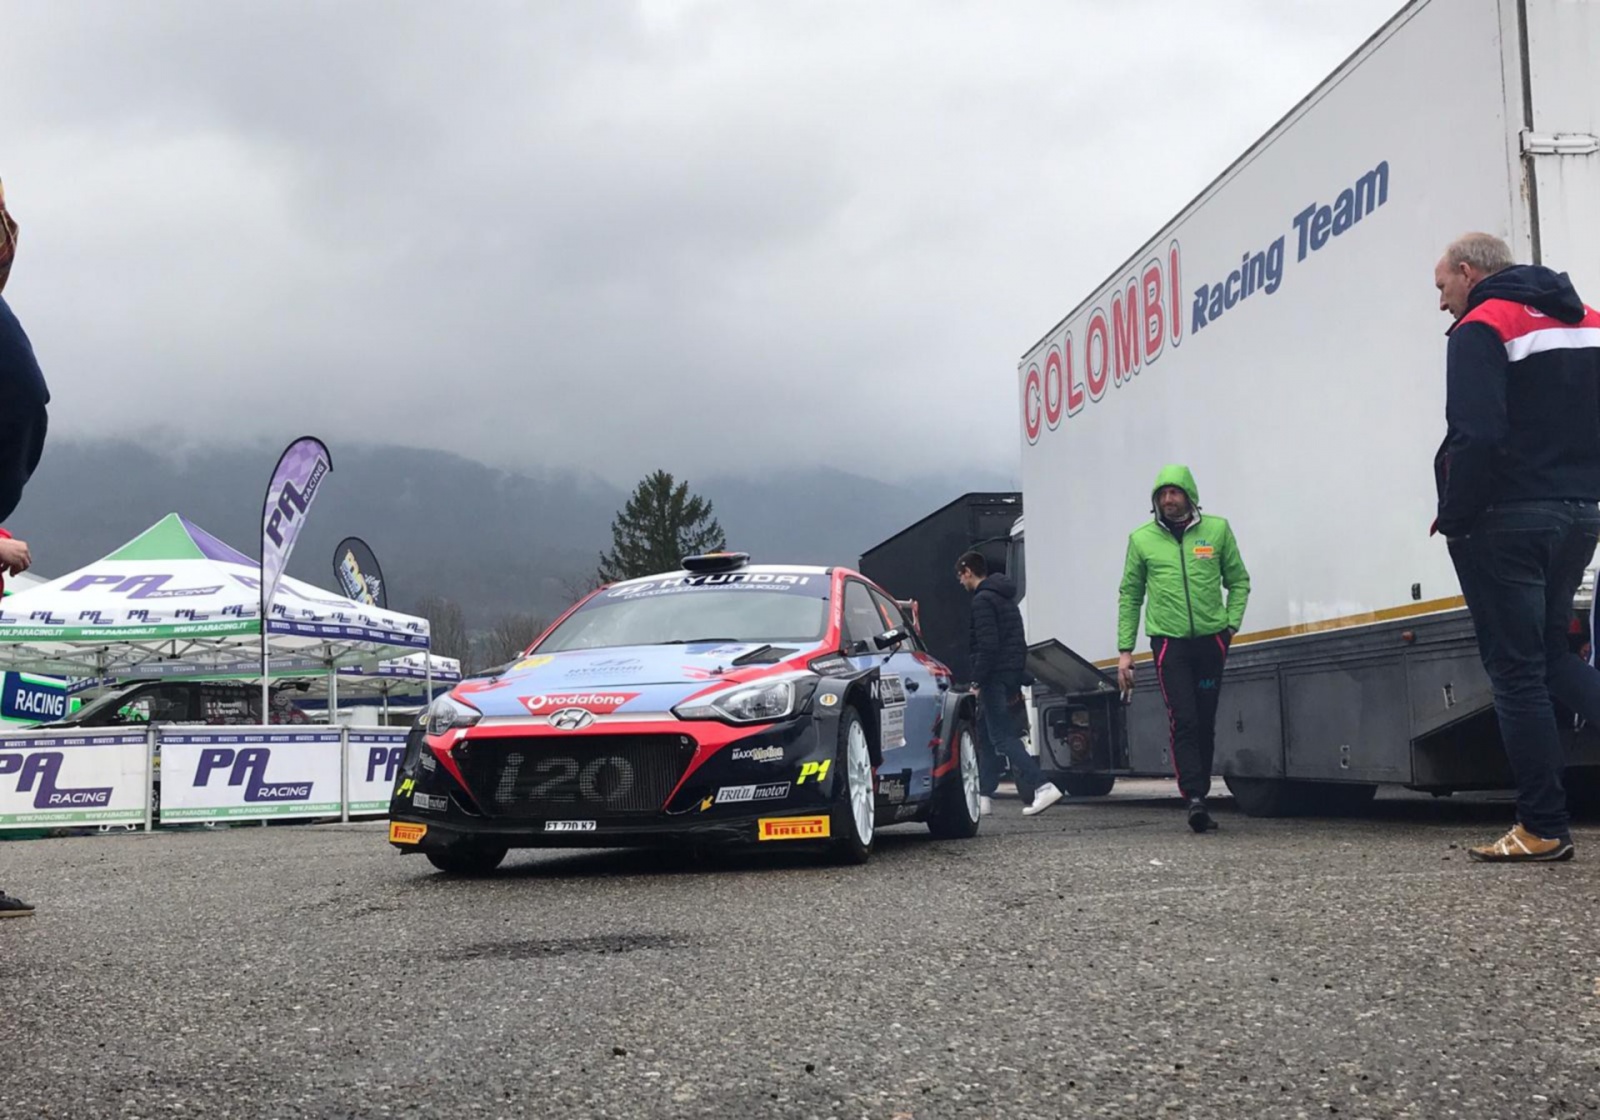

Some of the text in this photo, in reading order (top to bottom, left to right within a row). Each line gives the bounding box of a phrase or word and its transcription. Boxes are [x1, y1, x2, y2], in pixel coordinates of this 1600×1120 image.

[1192, 160, 1389, 335] Racing Team
[1023, 240, 1183, 445] COLOMBI
[303, 464, 325, 503] RACING
[266, 480, 305, 549] PA
[60, 574, 174, 599] PA
[660, 574, 810, 589] HYUNDAI
[15, 689, 64, 716] RACING
[547, 693, 626, 705] vodafone
[193, 748, 271, 802] PA
[496, 753, 634, 803] i20
[796, 759, 831, 785] P1
[49, 791, 107, 804] RACING
[258, 786, 308, 798] RACING
[755, 785, 788, 798] motor
[765, 819, 823, 836] PIRELLI
